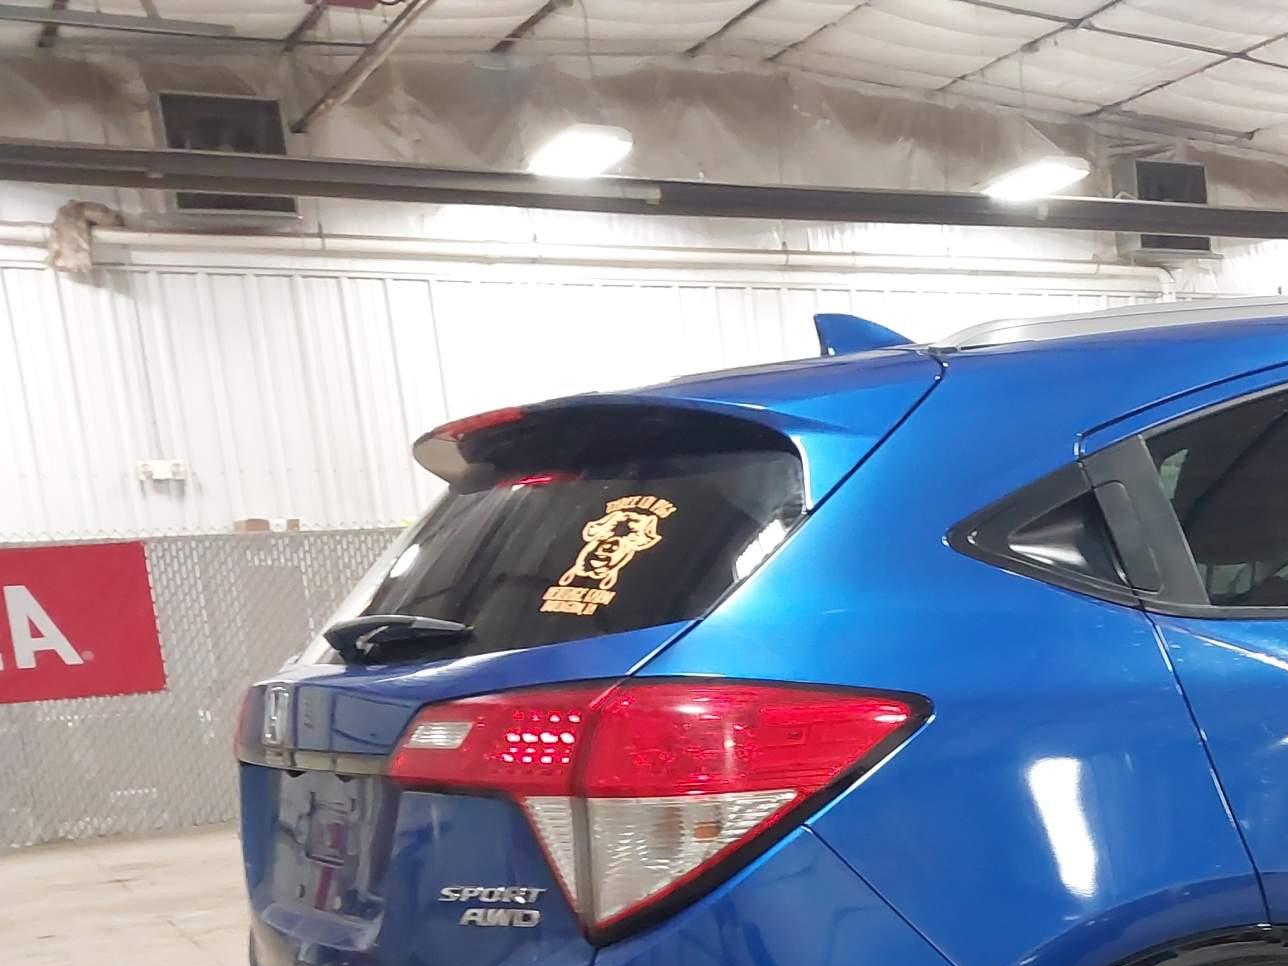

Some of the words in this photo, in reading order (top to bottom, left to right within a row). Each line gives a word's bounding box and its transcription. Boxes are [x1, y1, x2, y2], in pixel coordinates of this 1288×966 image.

[0, 584, 84, 671] A
[438, 886, 547, 903] SPORT
[460, 908, 540, 927] AWD
